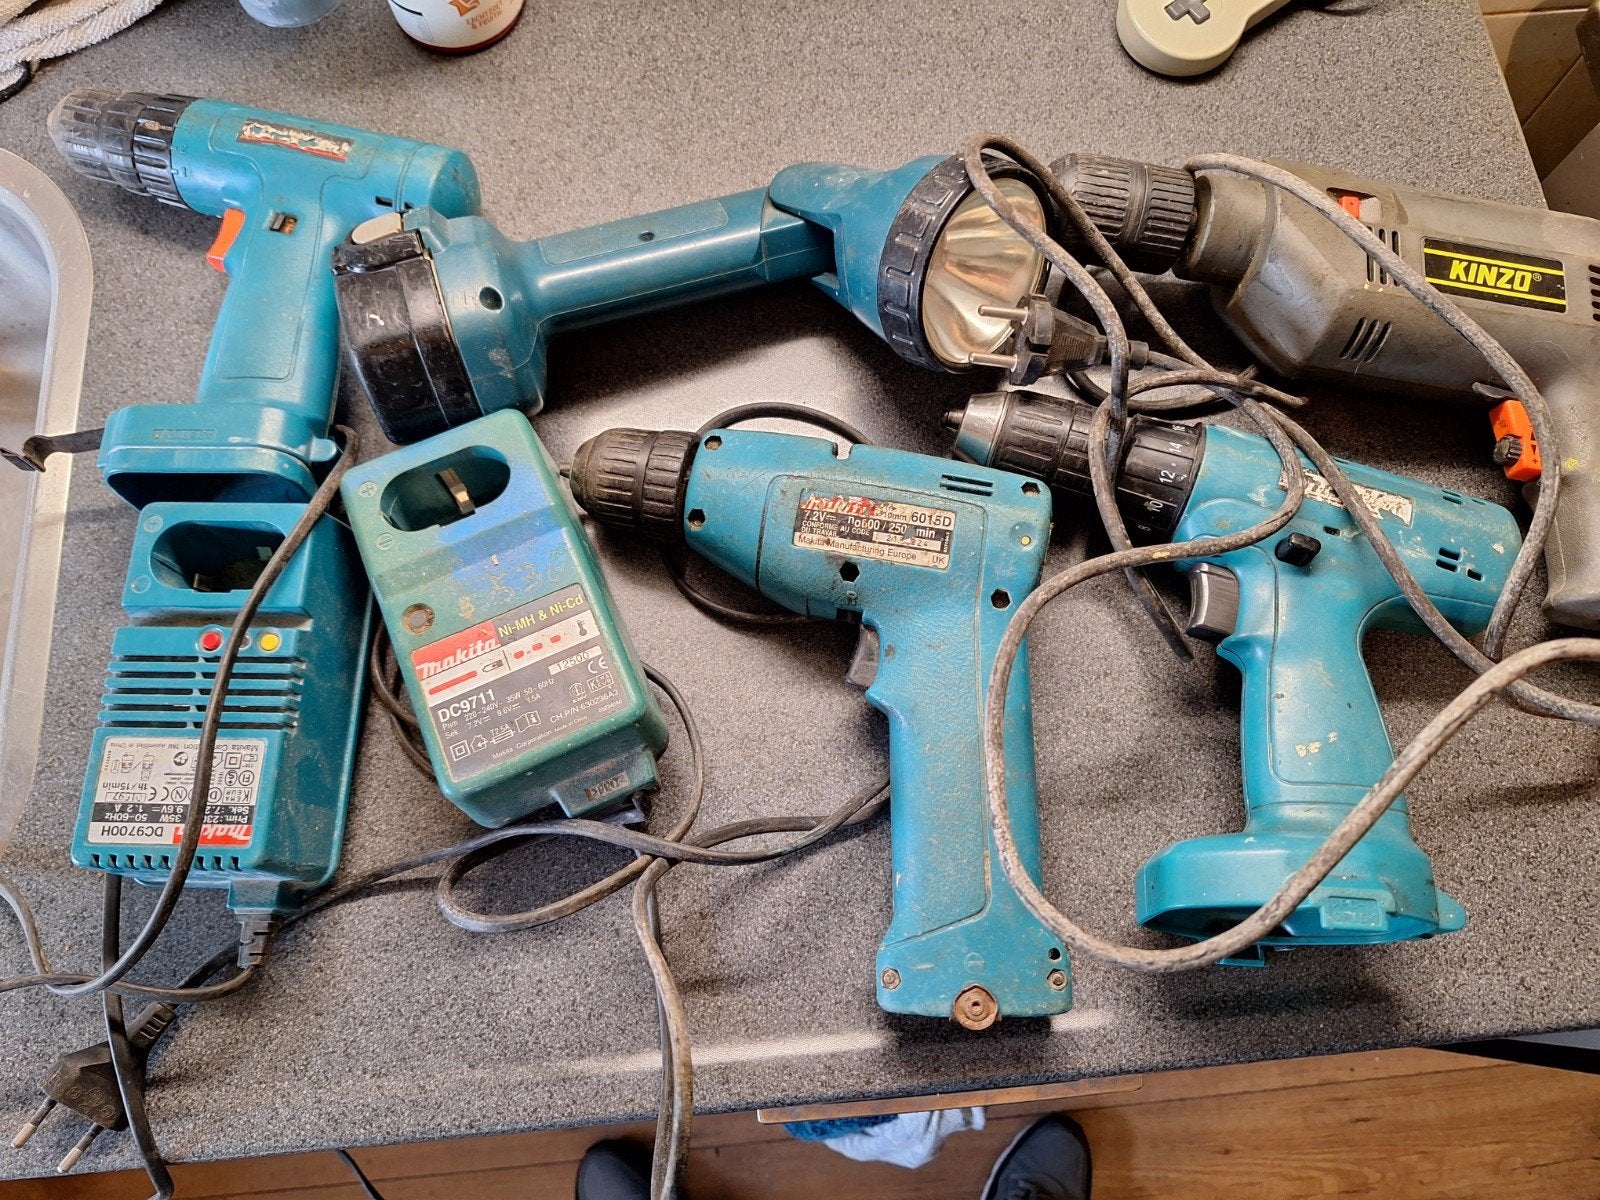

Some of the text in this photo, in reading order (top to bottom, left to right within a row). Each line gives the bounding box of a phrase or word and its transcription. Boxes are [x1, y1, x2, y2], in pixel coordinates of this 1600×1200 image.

[1159, 470, 1176, 483] 12
[911, 512, 952, 527] 6015D
[916, 528, 936, 539] min
[887, 548, 917, 560] Europe
[932, 555, 946, 564] UK
[498, 614, 536, 638] Ni-MH
[538, 610, 548, 621] &
[549, 594, 584, 616] Ni-Cd
[438, 688, 495, 722] DC9711
[159, 812, 182, 822] 35W
[101, 825, 164, 838] DC9700H
